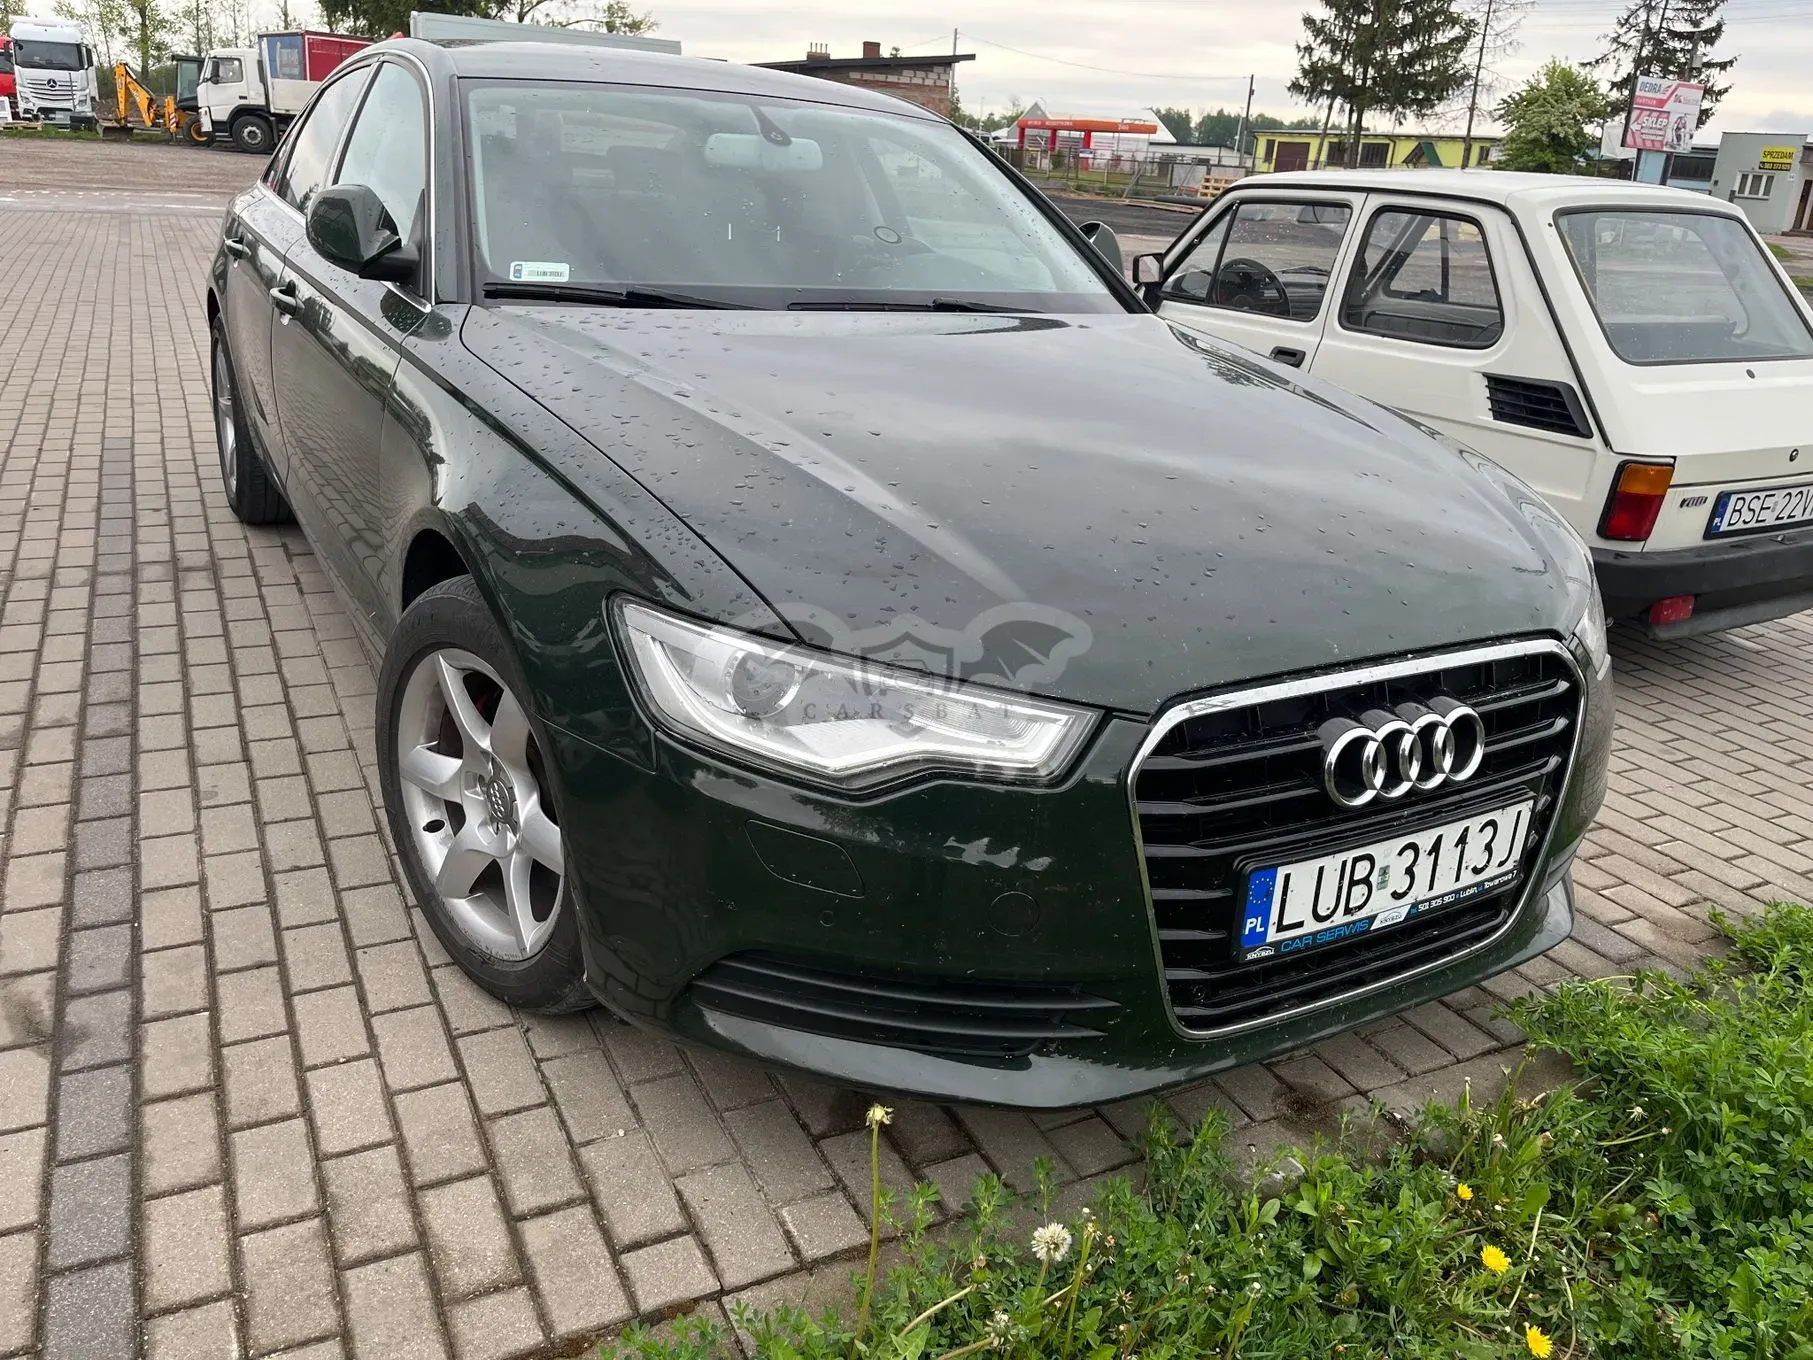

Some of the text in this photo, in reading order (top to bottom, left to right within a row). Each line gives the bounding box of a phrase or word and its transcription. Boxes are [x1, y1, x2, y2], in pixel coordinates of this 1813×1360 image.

[1639, 82, 1662, 94] DEDRA
[1642, 117, 1668, 128] SKLEP
[1763, 150, 1794, 160] SPRZEDAM
[1727, 489, 1813, 527] BSE 22V
[1276, 810, 1522, 934] LUB 3113J
[1418, 901, 1430, 912] 501
[1245, 916, 1265, 935] PL
[1281, 919, 1369, 952] CAR SERWIS
